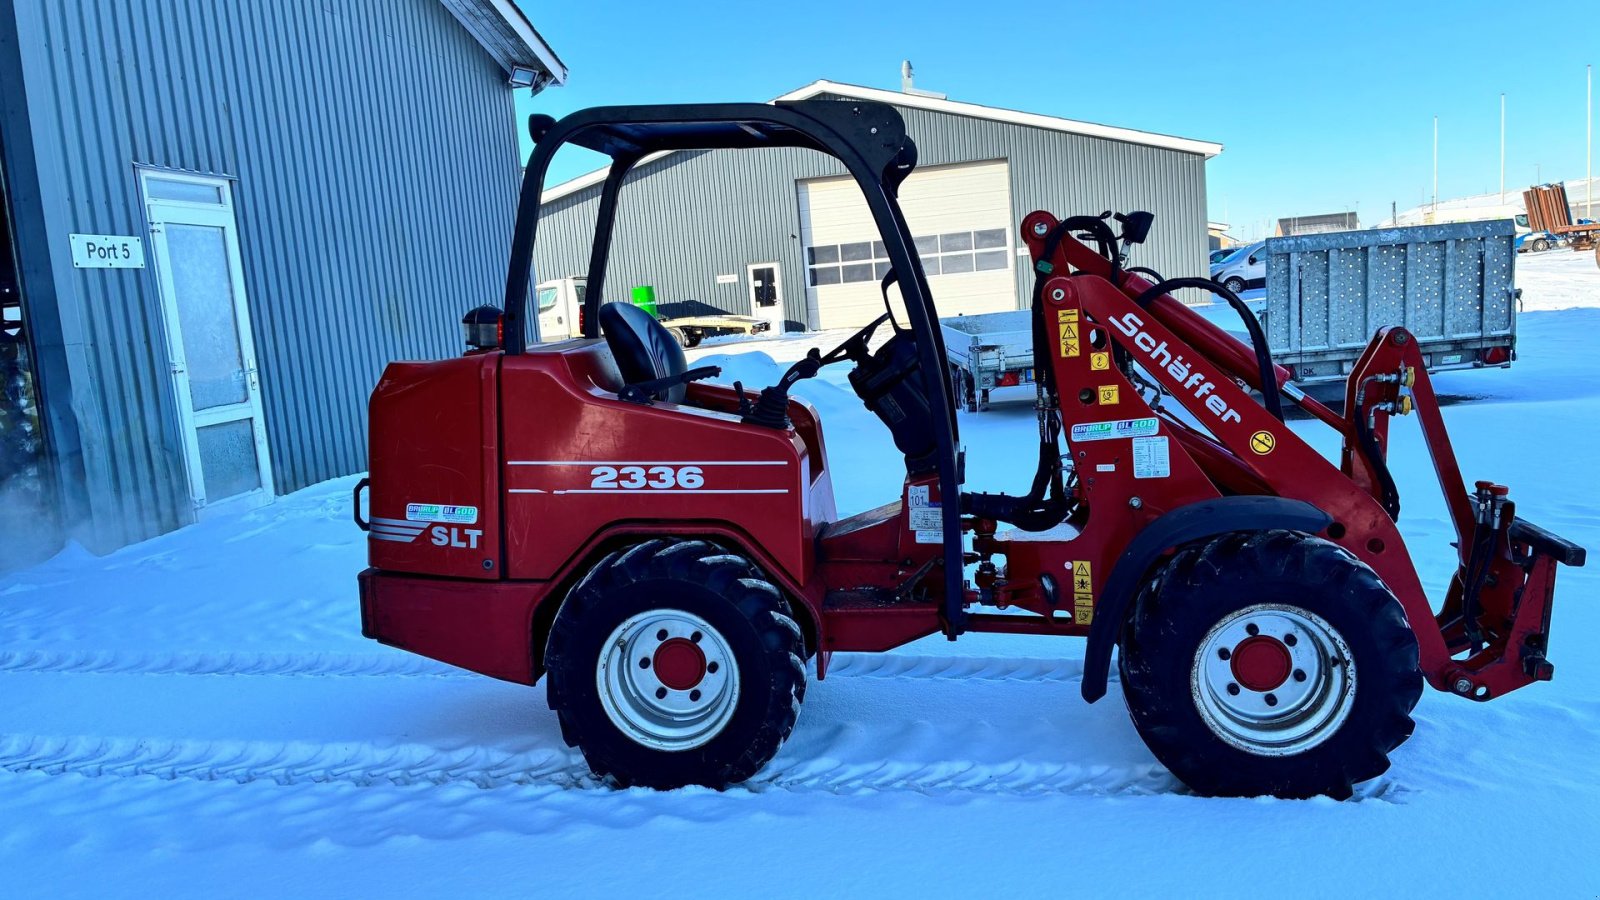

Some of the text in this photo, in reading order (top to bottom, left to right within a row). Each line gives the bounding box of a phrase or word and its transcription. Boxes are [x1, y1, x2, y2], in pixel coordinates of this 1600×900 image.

[86, 241, 130, 259] Port 5
[1108, 312, 1242, 424] Schäffer
[590, 466, 705, 489] 2336
[911, 495, 924, 506] 101
[431, 525, 483, 549] SLT
